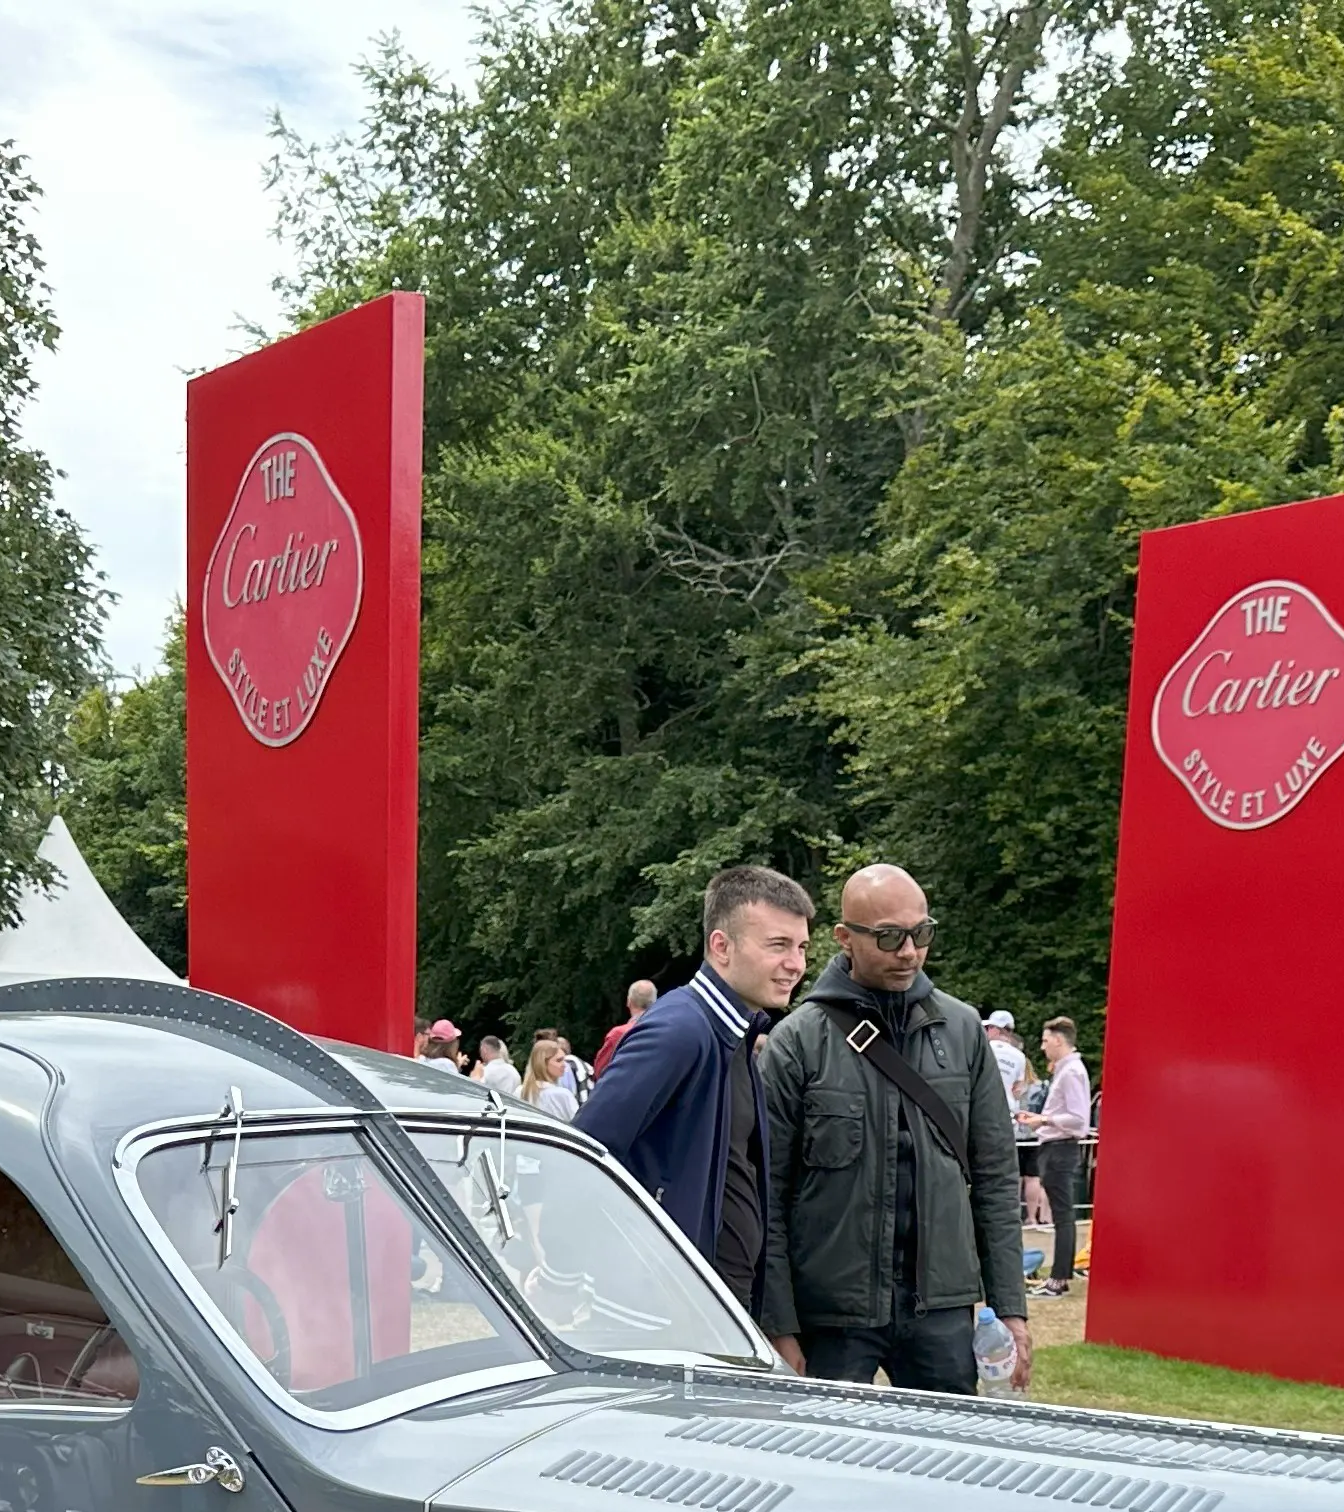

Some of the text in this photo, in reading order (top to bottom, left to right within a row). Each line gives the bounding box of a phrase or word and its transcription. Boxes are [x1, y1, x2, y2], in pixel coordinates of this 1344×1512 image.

[260, 451, 297, 503] THE
[222, 524, 339, 608] Cartier
[1241, 595, 1291, 637] THE
[227, 625, 334, 732] STYLE ET LUXE
[1181, 650, 1340, 718] Cartier
[1183, 736, 1327, 818] STYLE ET LUXE
